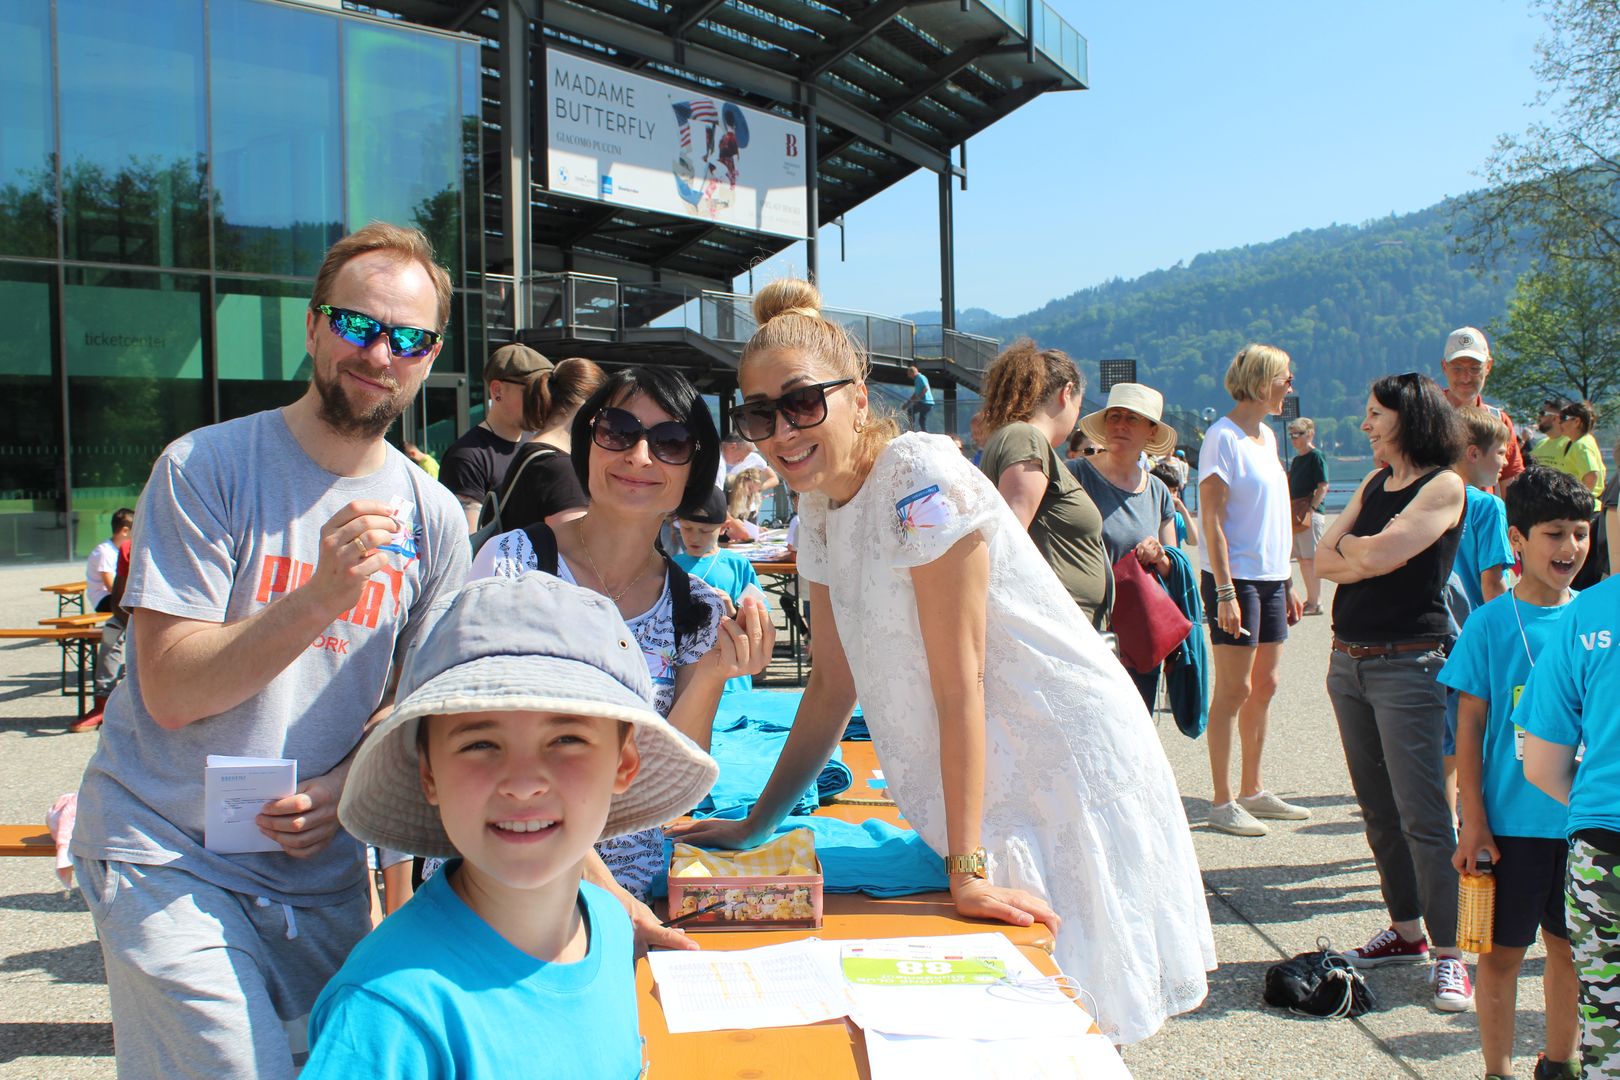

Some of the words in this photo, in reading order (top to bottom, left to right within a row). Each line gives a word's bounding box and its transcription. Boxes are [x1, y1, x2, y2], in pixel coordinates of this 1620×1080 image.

[554, 66, 635, 108] MADAME
[555, 97, 656, 141] BUTTERFLY
[556, 131, 592, 148] GIACOMO
[592, 140, 622, 155] PUCCINI
[84, 331, 168, 349] ticketcenter
[312, 634, 350, 655] ORK
[1578, 630, 1612, 651] VS
[895, 960, 953, 975] 88
